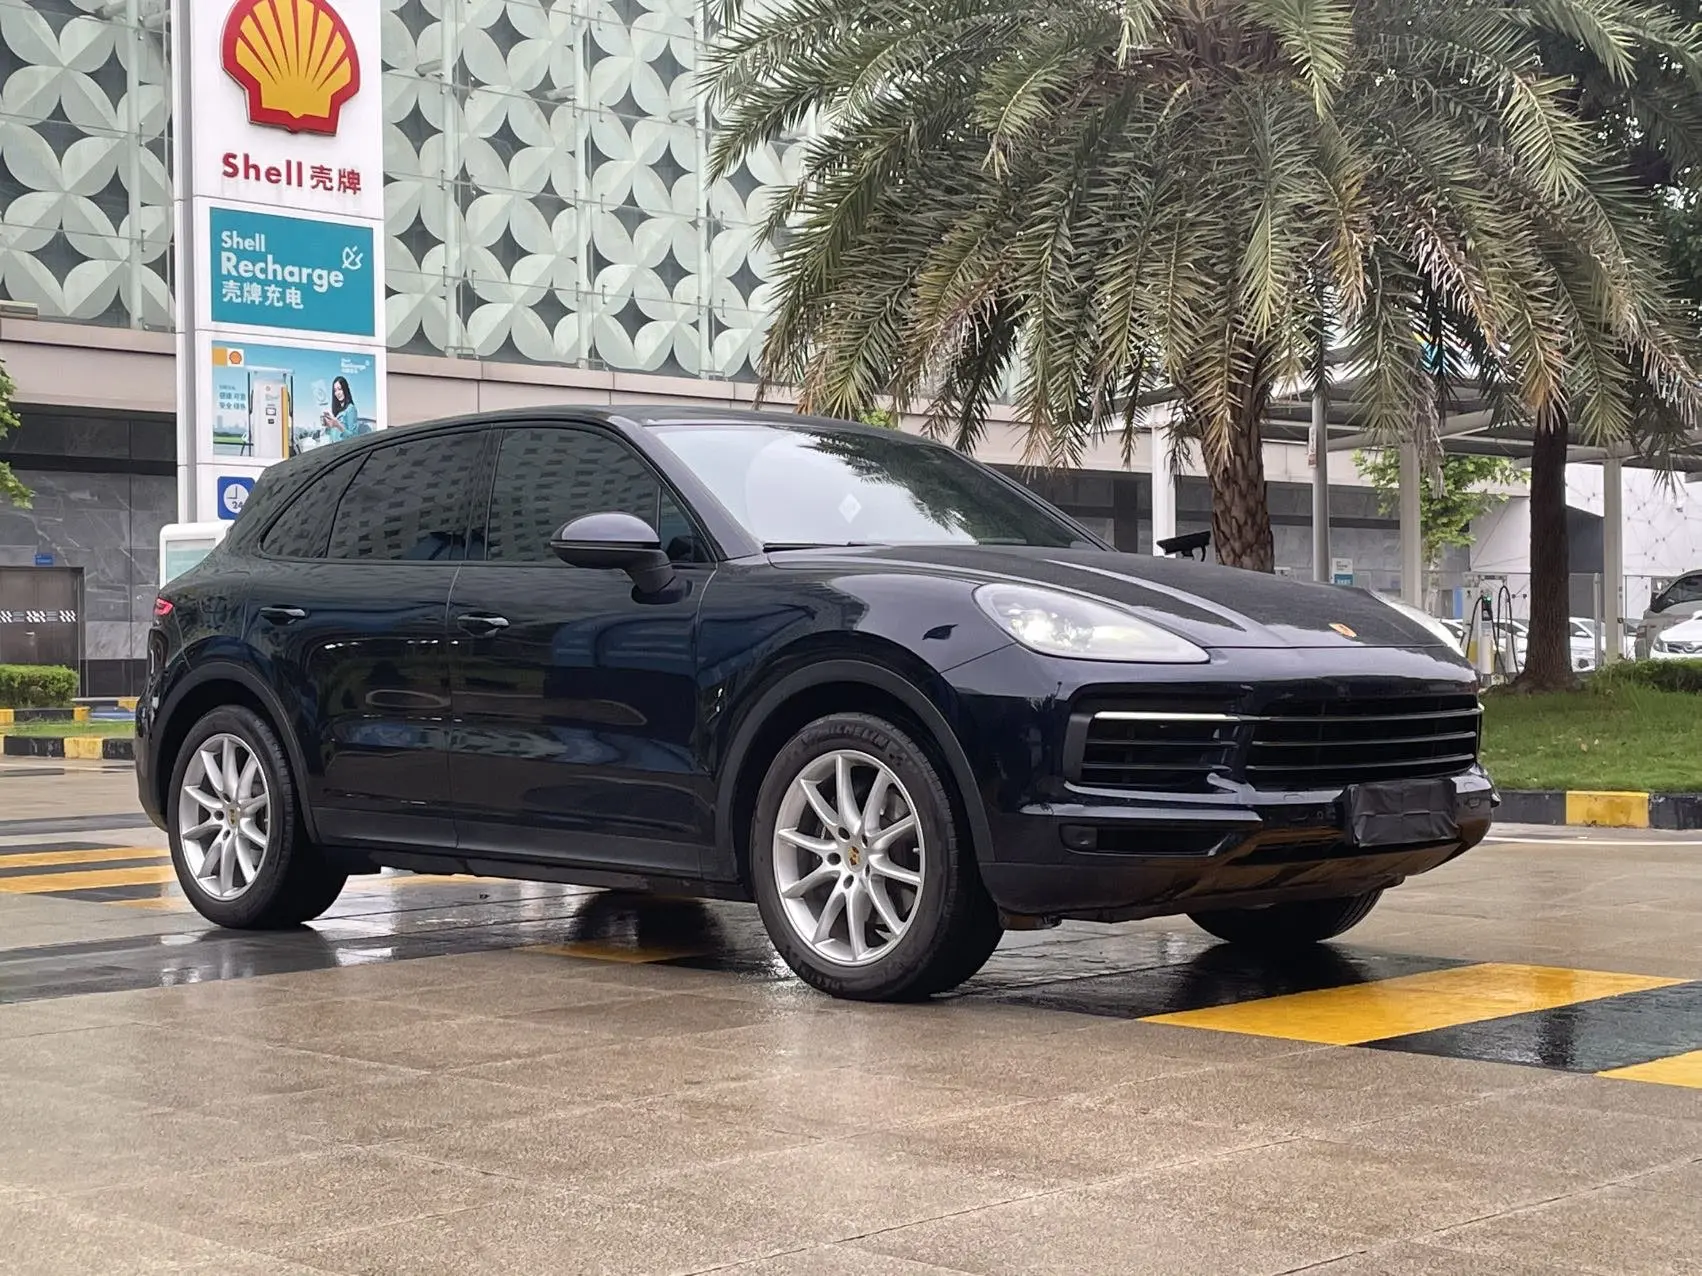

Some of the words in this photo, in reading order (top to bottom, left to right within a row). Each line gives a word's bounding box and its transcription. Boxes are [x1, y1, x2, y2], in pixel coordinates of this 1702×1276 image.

[222, 152, 303, 188] Shell
[309, 164, 362, 195] 壳牌
[221, 230, 266, 252] Shell
[221, 251, 344, 293] Recharge
[221, 279, 304, 309] 壳牌充电
